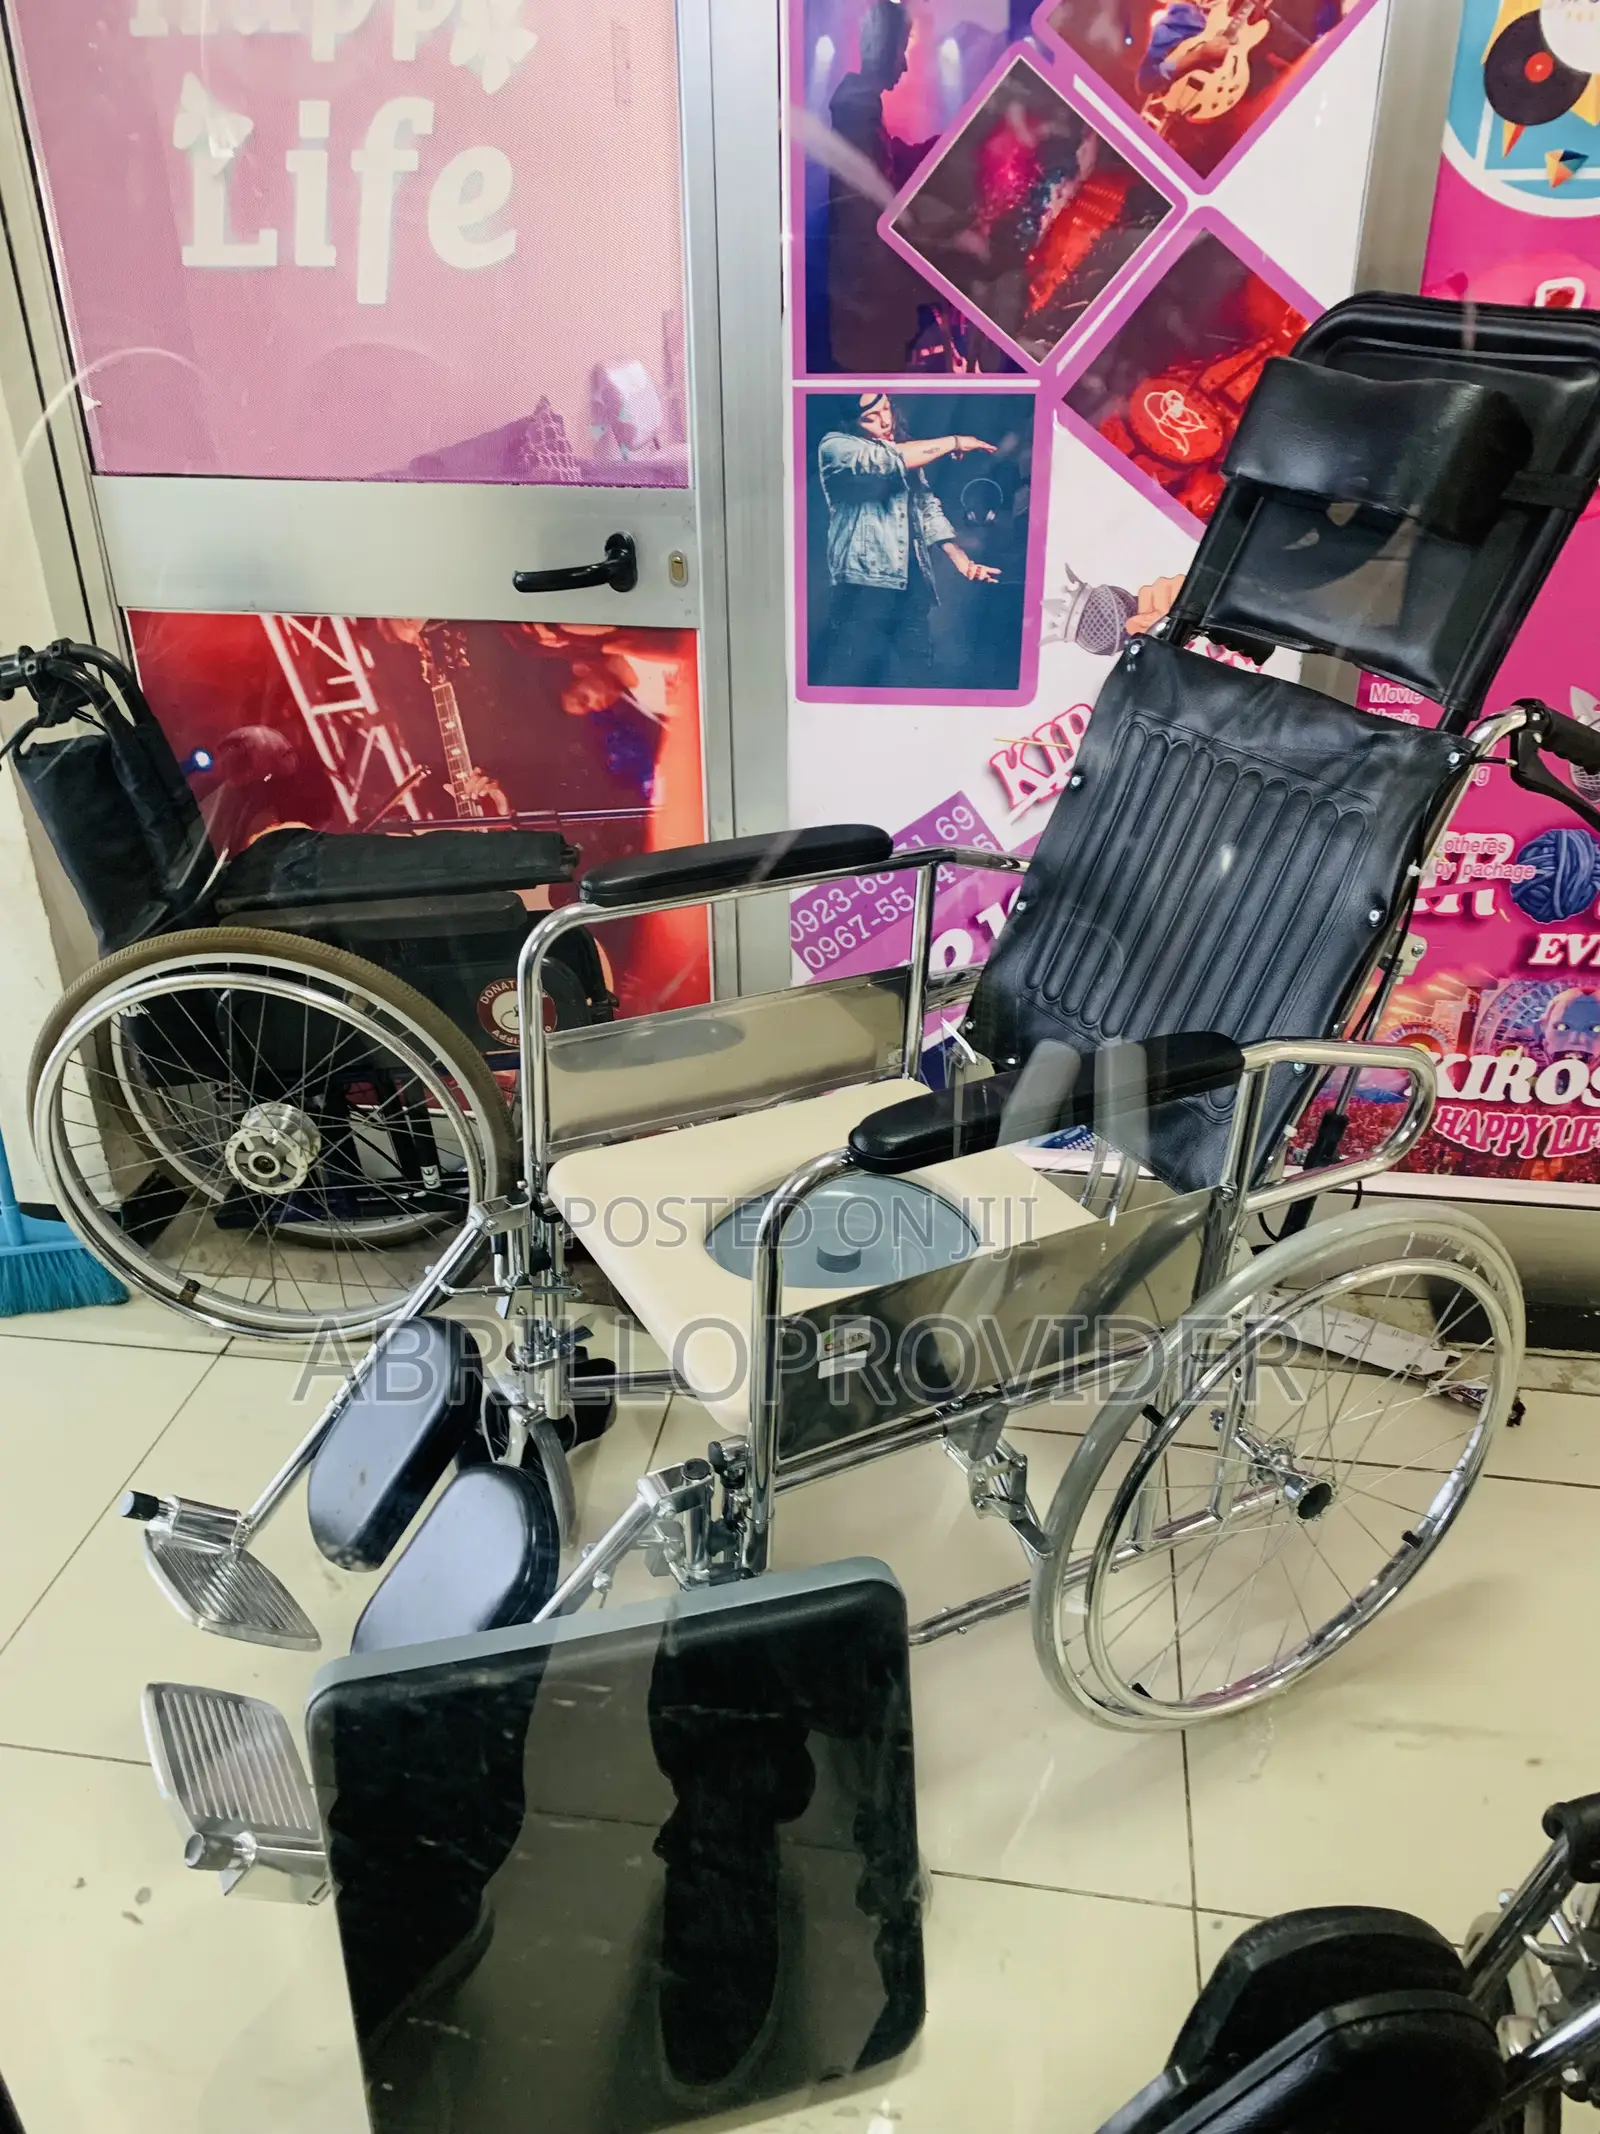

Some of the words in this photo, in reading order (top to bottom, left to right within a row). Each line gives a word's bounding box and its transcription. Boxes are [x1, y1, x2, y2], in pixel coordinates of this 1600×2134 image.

[180, 96, 517, 304] Life
[1370, 683, 1424, 703] Movie
[936, 805, 975, 842] 69
[1434, 860, 1457, 880] by
[803, 887, 915, 970] 0967-55
[1528, 933, 1600, 966] EV
[1433, 1106, 1550, 1159] HAPPY
